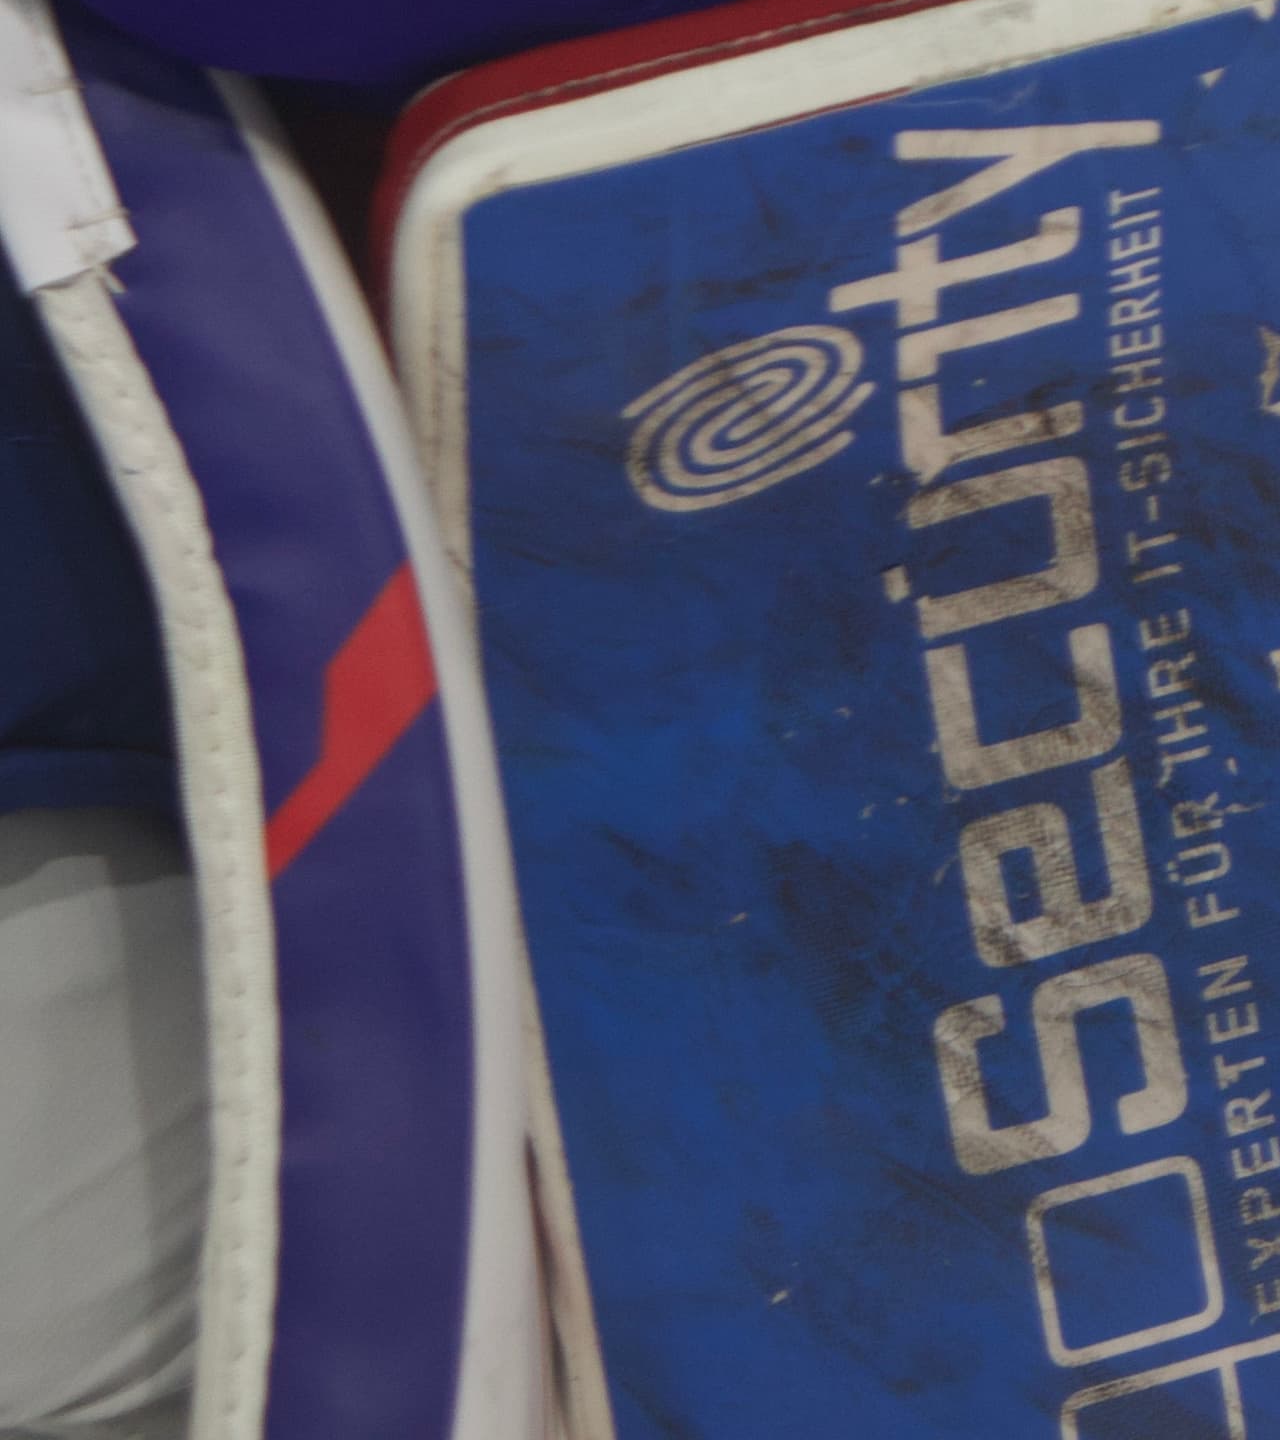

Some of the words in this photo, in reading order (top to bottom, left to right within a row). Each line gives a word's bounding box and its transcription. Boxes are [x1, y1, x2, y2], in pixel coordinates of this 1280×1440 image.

[1107, 186, 1184, 584] IT-SICHERHEIT
[1140, 606, 1214, 778] IHRE
[1168, 790, 1241, 929] FÜR
